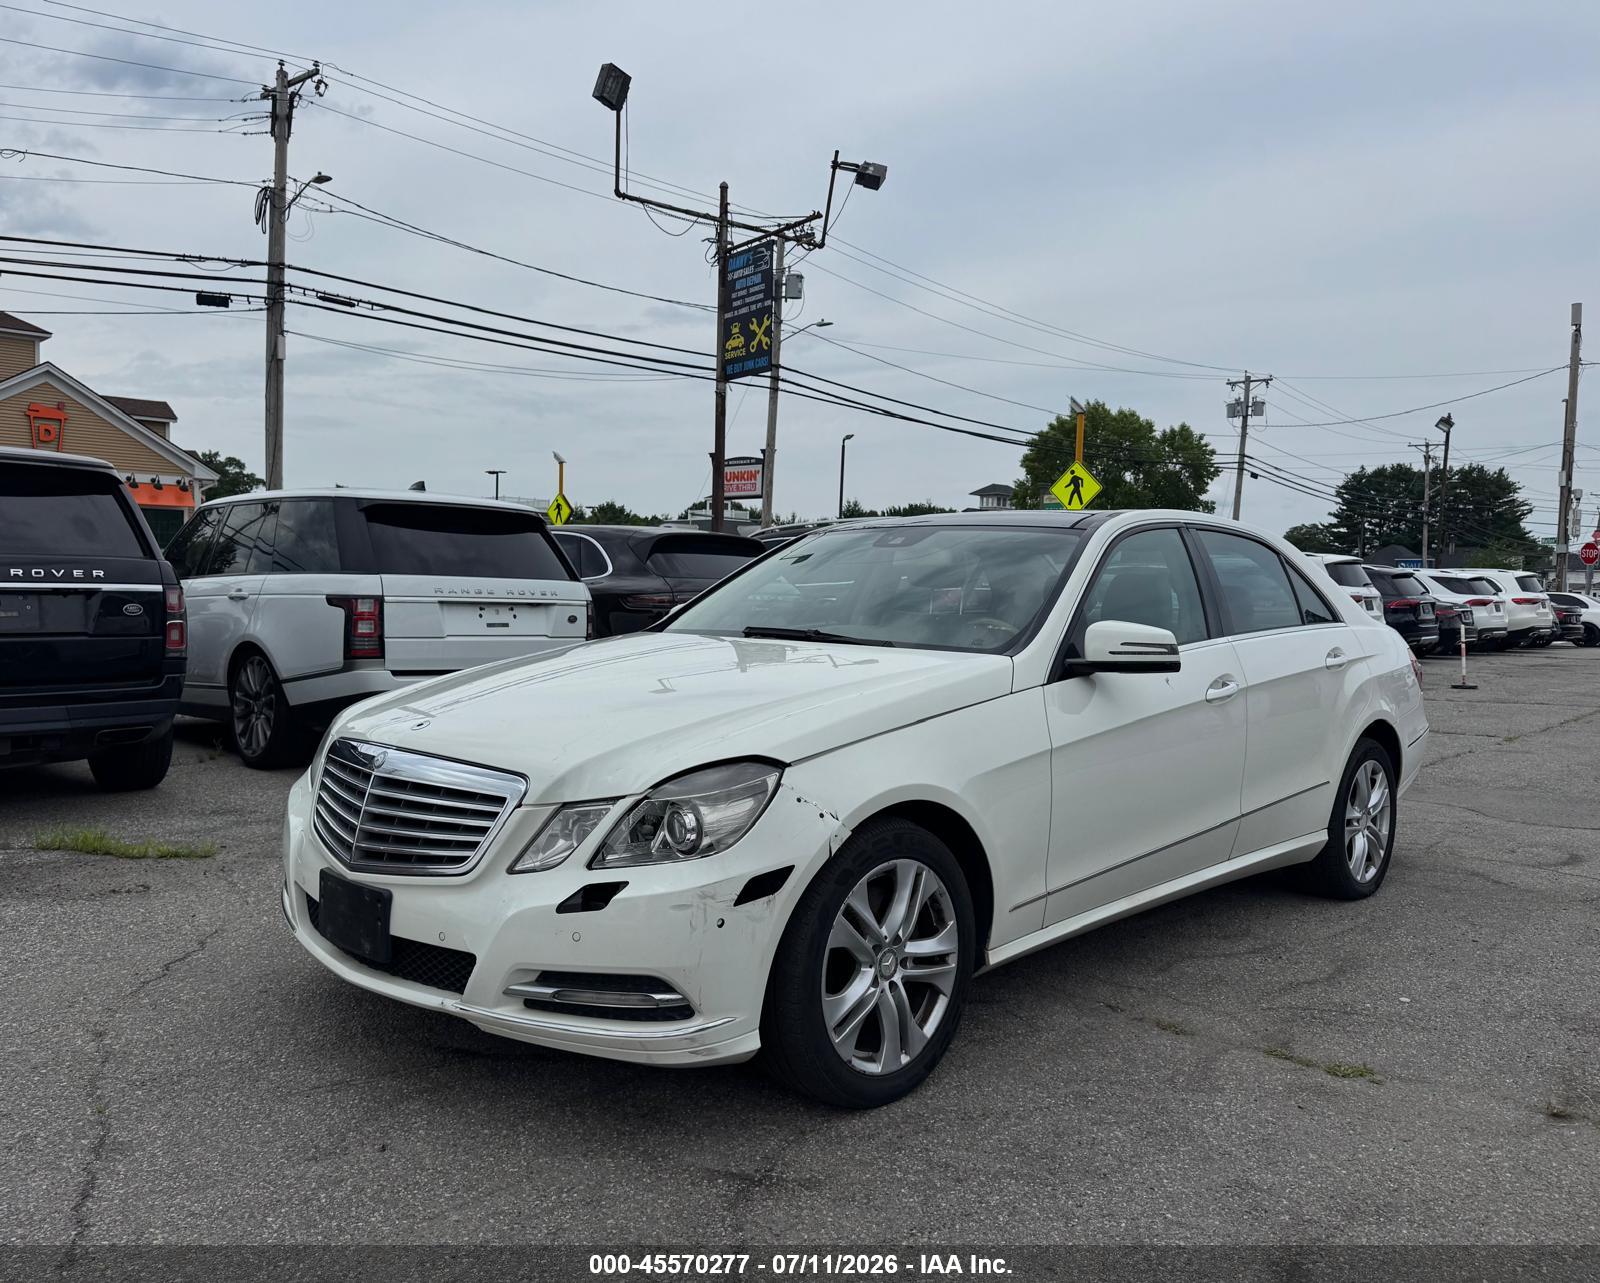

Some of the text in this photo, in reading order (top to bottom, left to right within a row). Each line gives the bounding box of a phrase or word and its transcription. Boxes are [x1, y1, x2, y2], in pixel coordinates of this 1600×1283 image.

[725, 348, 746, 360] SERVICE
[725, 469, 760, 482] UNKIN'
[724, 482, 757, 492] RIVE THRU
[1581, 548, 1598, 558] STOP
[9, 568, 105, 578] ROVER
[434, 587, 559, 597] RANGE ROVER
